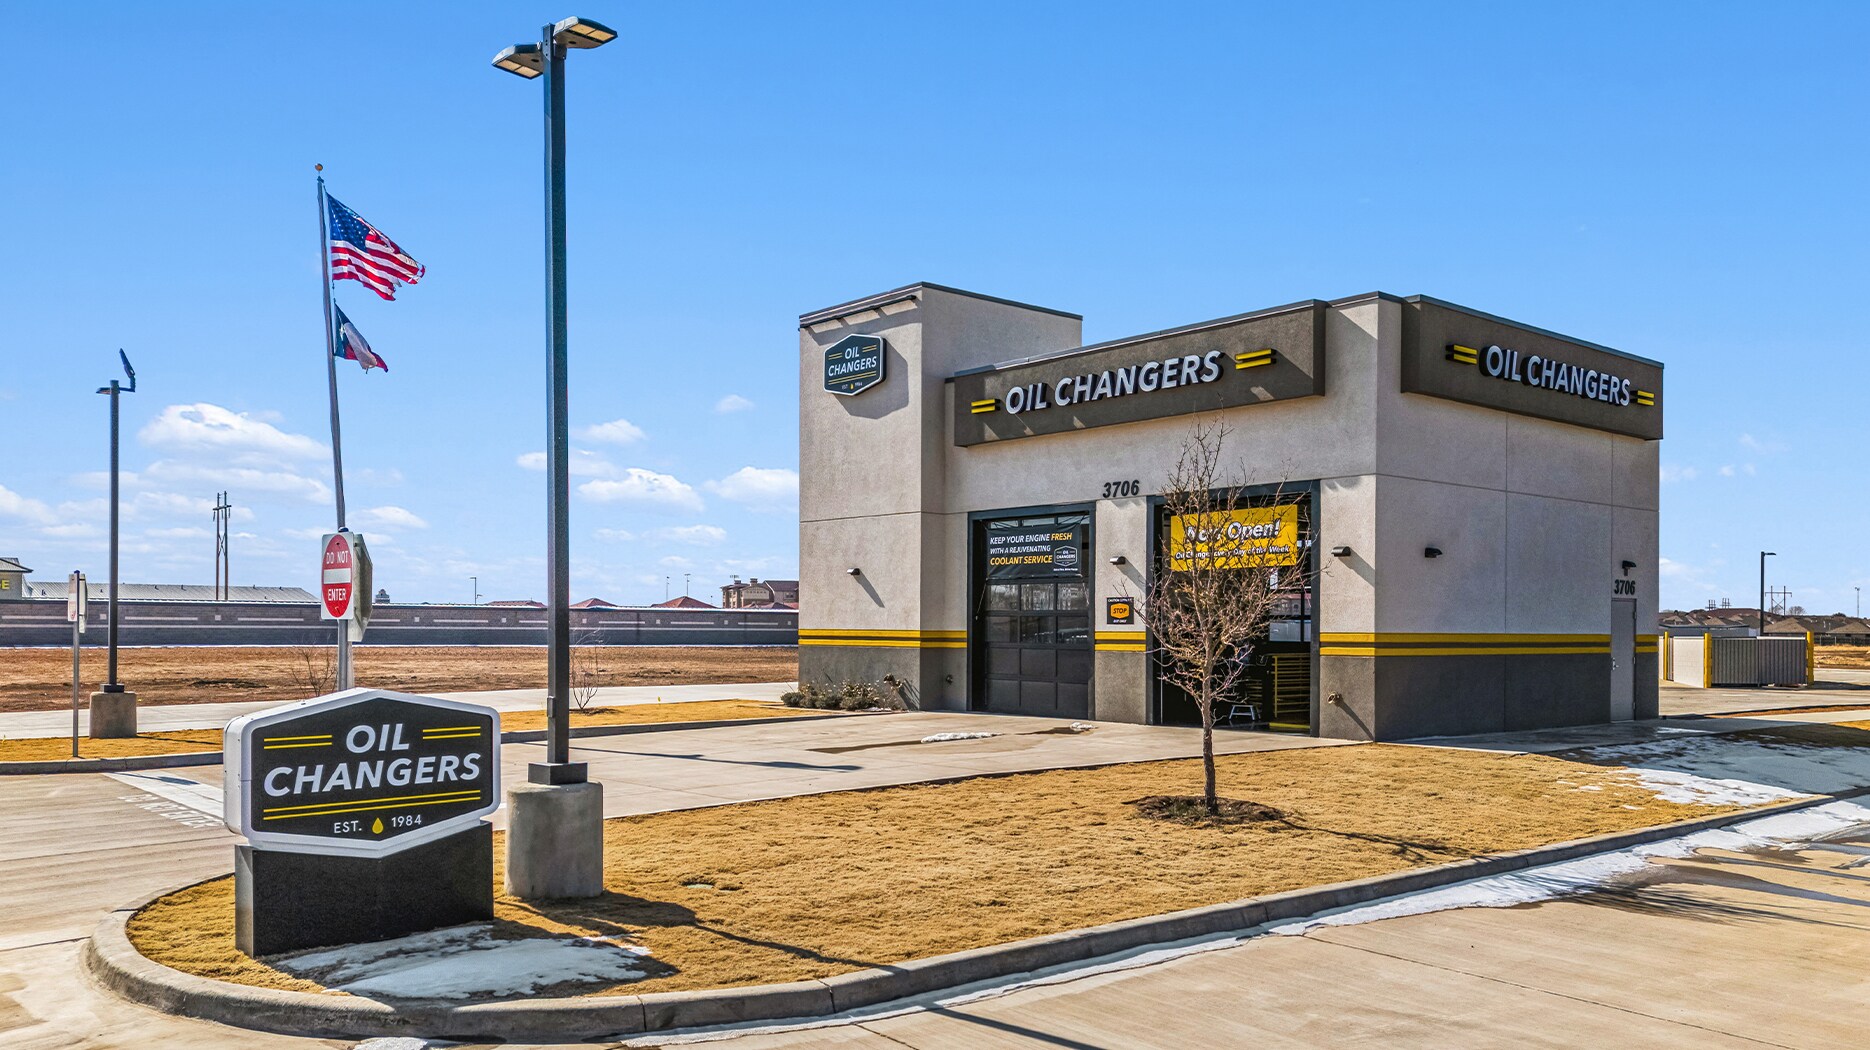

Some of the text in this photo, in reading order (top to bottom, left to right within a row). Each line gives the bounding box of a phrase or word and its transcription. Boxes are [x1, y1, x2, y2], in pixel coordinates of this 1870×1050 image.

[845, 346, 860, 360] OIL
[828, 356, 877, 376] CHANGERS
[1005, 350, 1223, 415] OIL CHANGERS
[1486, 345, 1631, 407] OIL CHANGERS
[1102, 480, 1140, 498] 3706
[990, 532, 1073, 545] KEEP YOUR ENGINE FRESH
[1227, 519, 1281, 543] Open!
[326, 550, 349, 564] DO NOT
[1009, 545, 1051, 554] REJUVENATING
[1269, 545, 1289, 554] Week
[990, 555, 1053, 566] COOLANT SERVICE
[327, 588, 347, 602] ENTER
[1613, 579, 1636, 595] 3706
[1112, 607, 1128, 615] STOP
[345, 723, 410, 754] OIL
[263, 752, 482, 797] CHANGERS
[333, 814, 422, 834] EST. 1984
